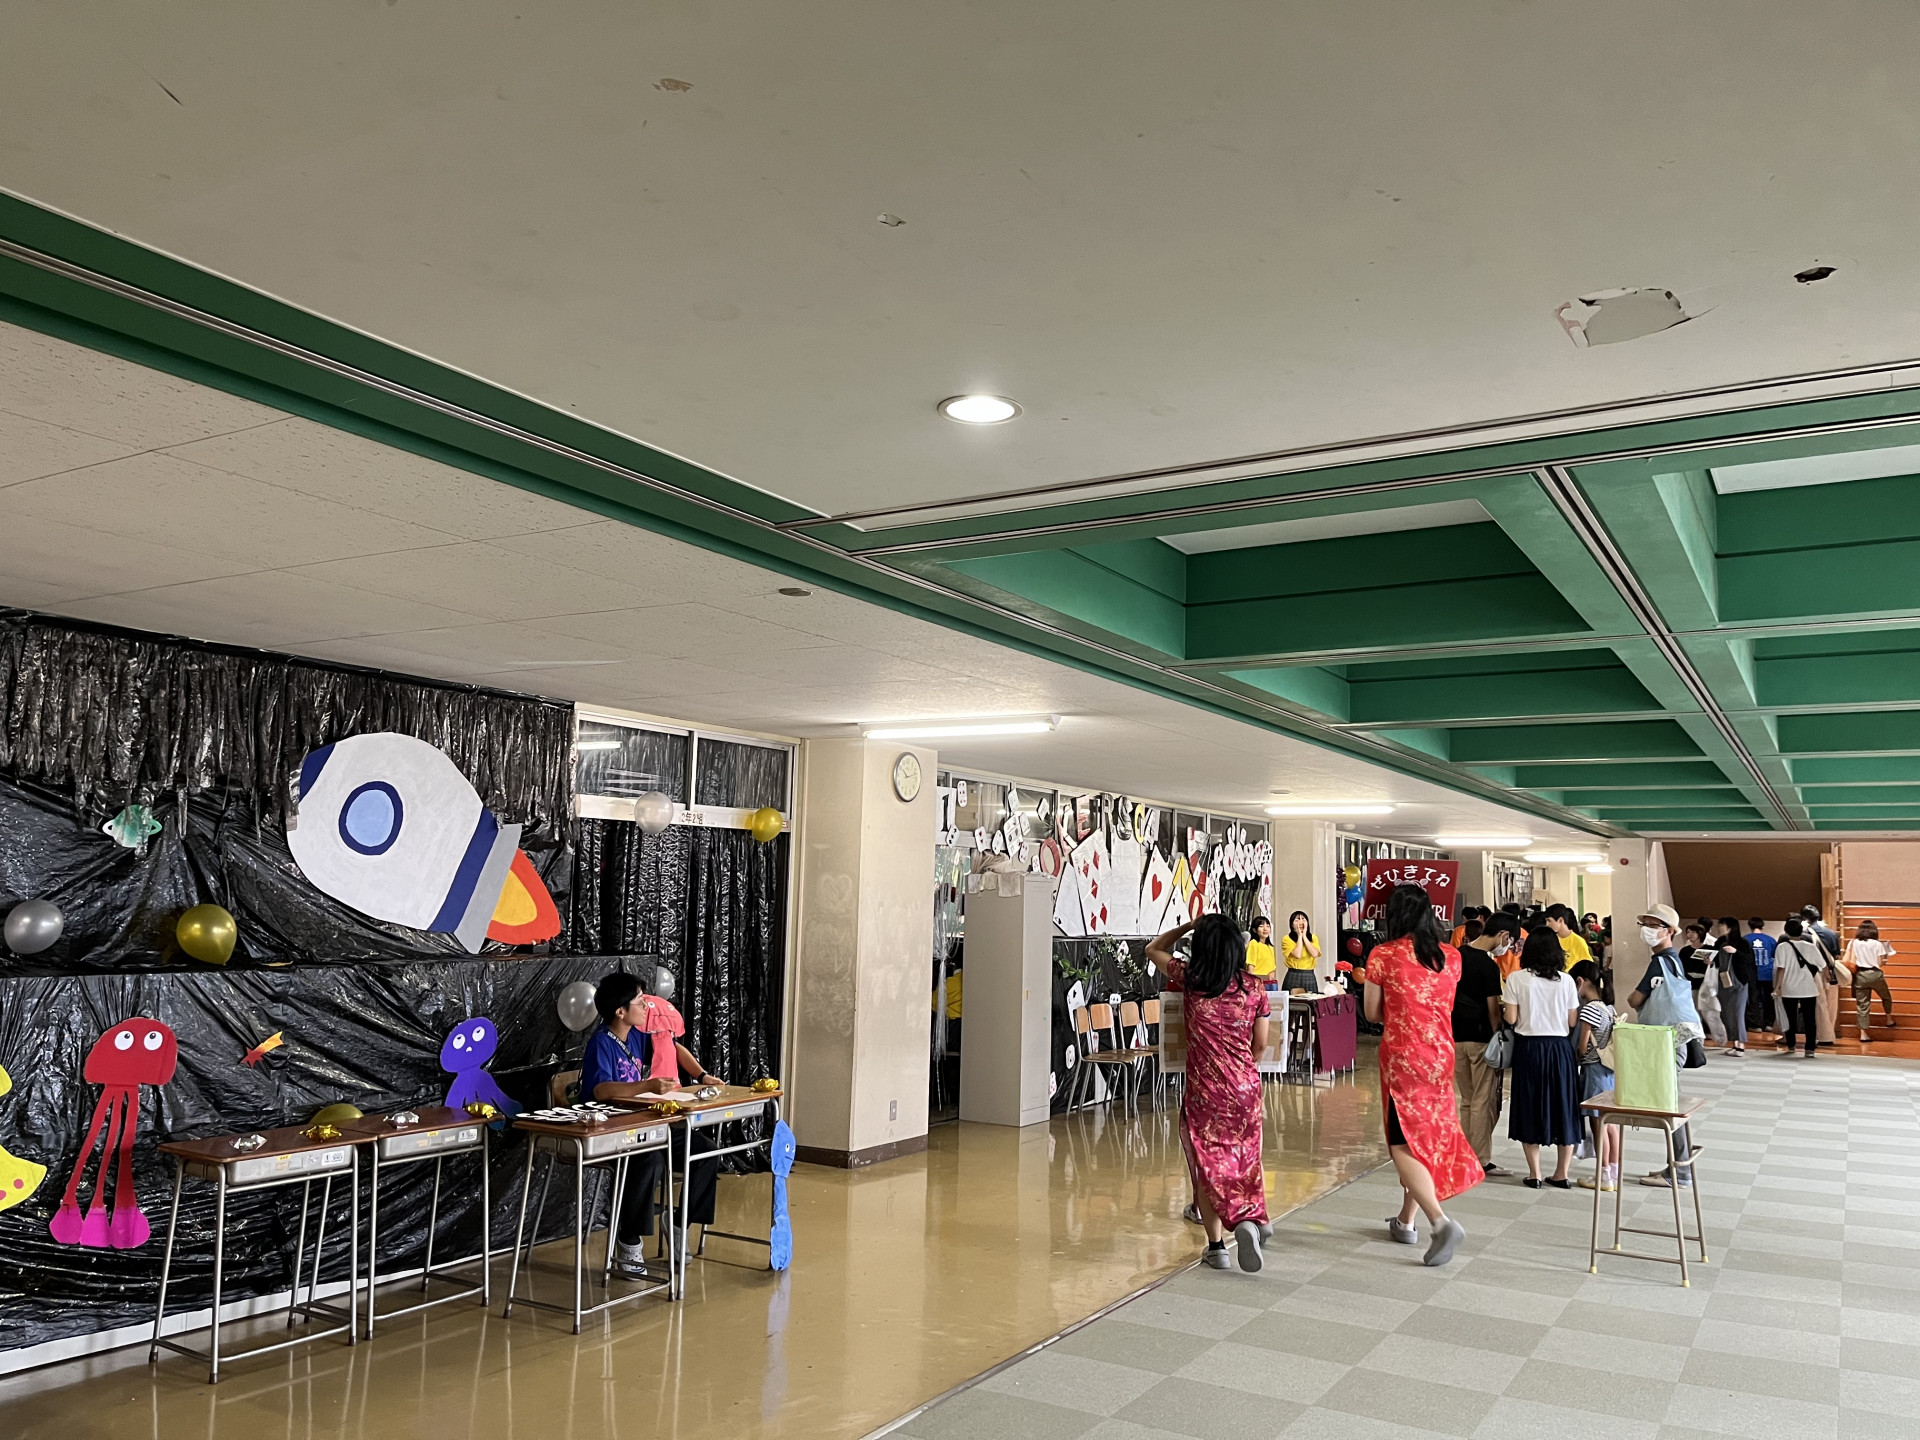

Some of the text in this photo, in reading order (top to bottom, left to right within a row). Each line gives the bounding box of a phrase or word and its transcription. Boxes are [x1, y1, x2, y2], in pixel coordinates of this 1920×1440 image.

[1040, 792, 1134, 878] OKERS
[1370, 865, 1451, 890] ぜひきてね
